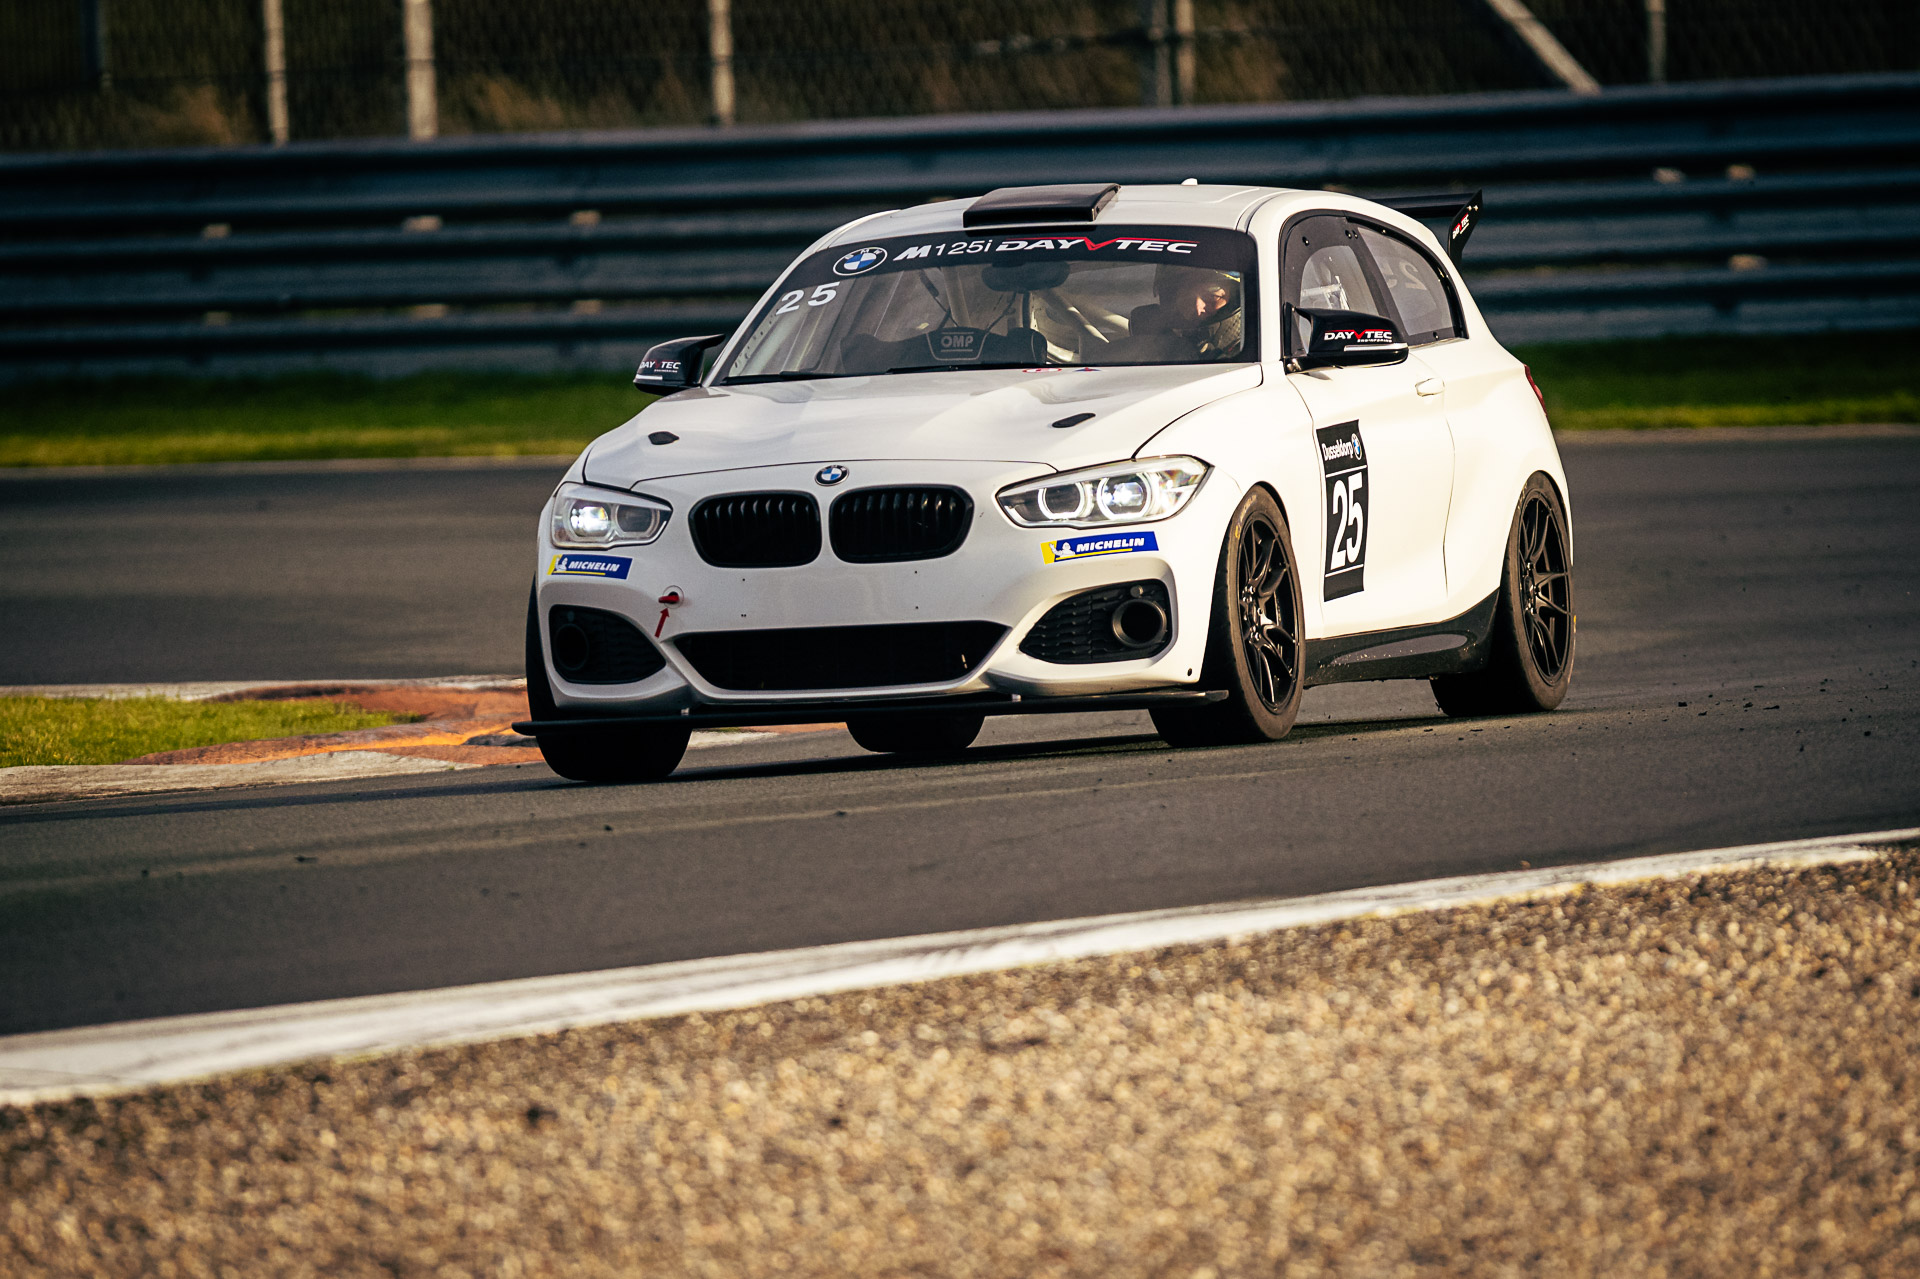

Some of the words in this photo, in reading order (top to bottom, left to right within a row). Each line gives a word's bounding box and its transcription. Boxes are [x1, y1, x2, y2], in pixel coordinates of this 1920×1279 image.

[775, 281, 841, 316] 25
[940, 335, 974, 348] OMP
[1321, 438, 1354, 461] Dusseldorp
[1330, 471, 1364, 571] 25
[1076, 537, 1145, 553] MICHELIN
[568, 560, 620, 573] MICHELIN
